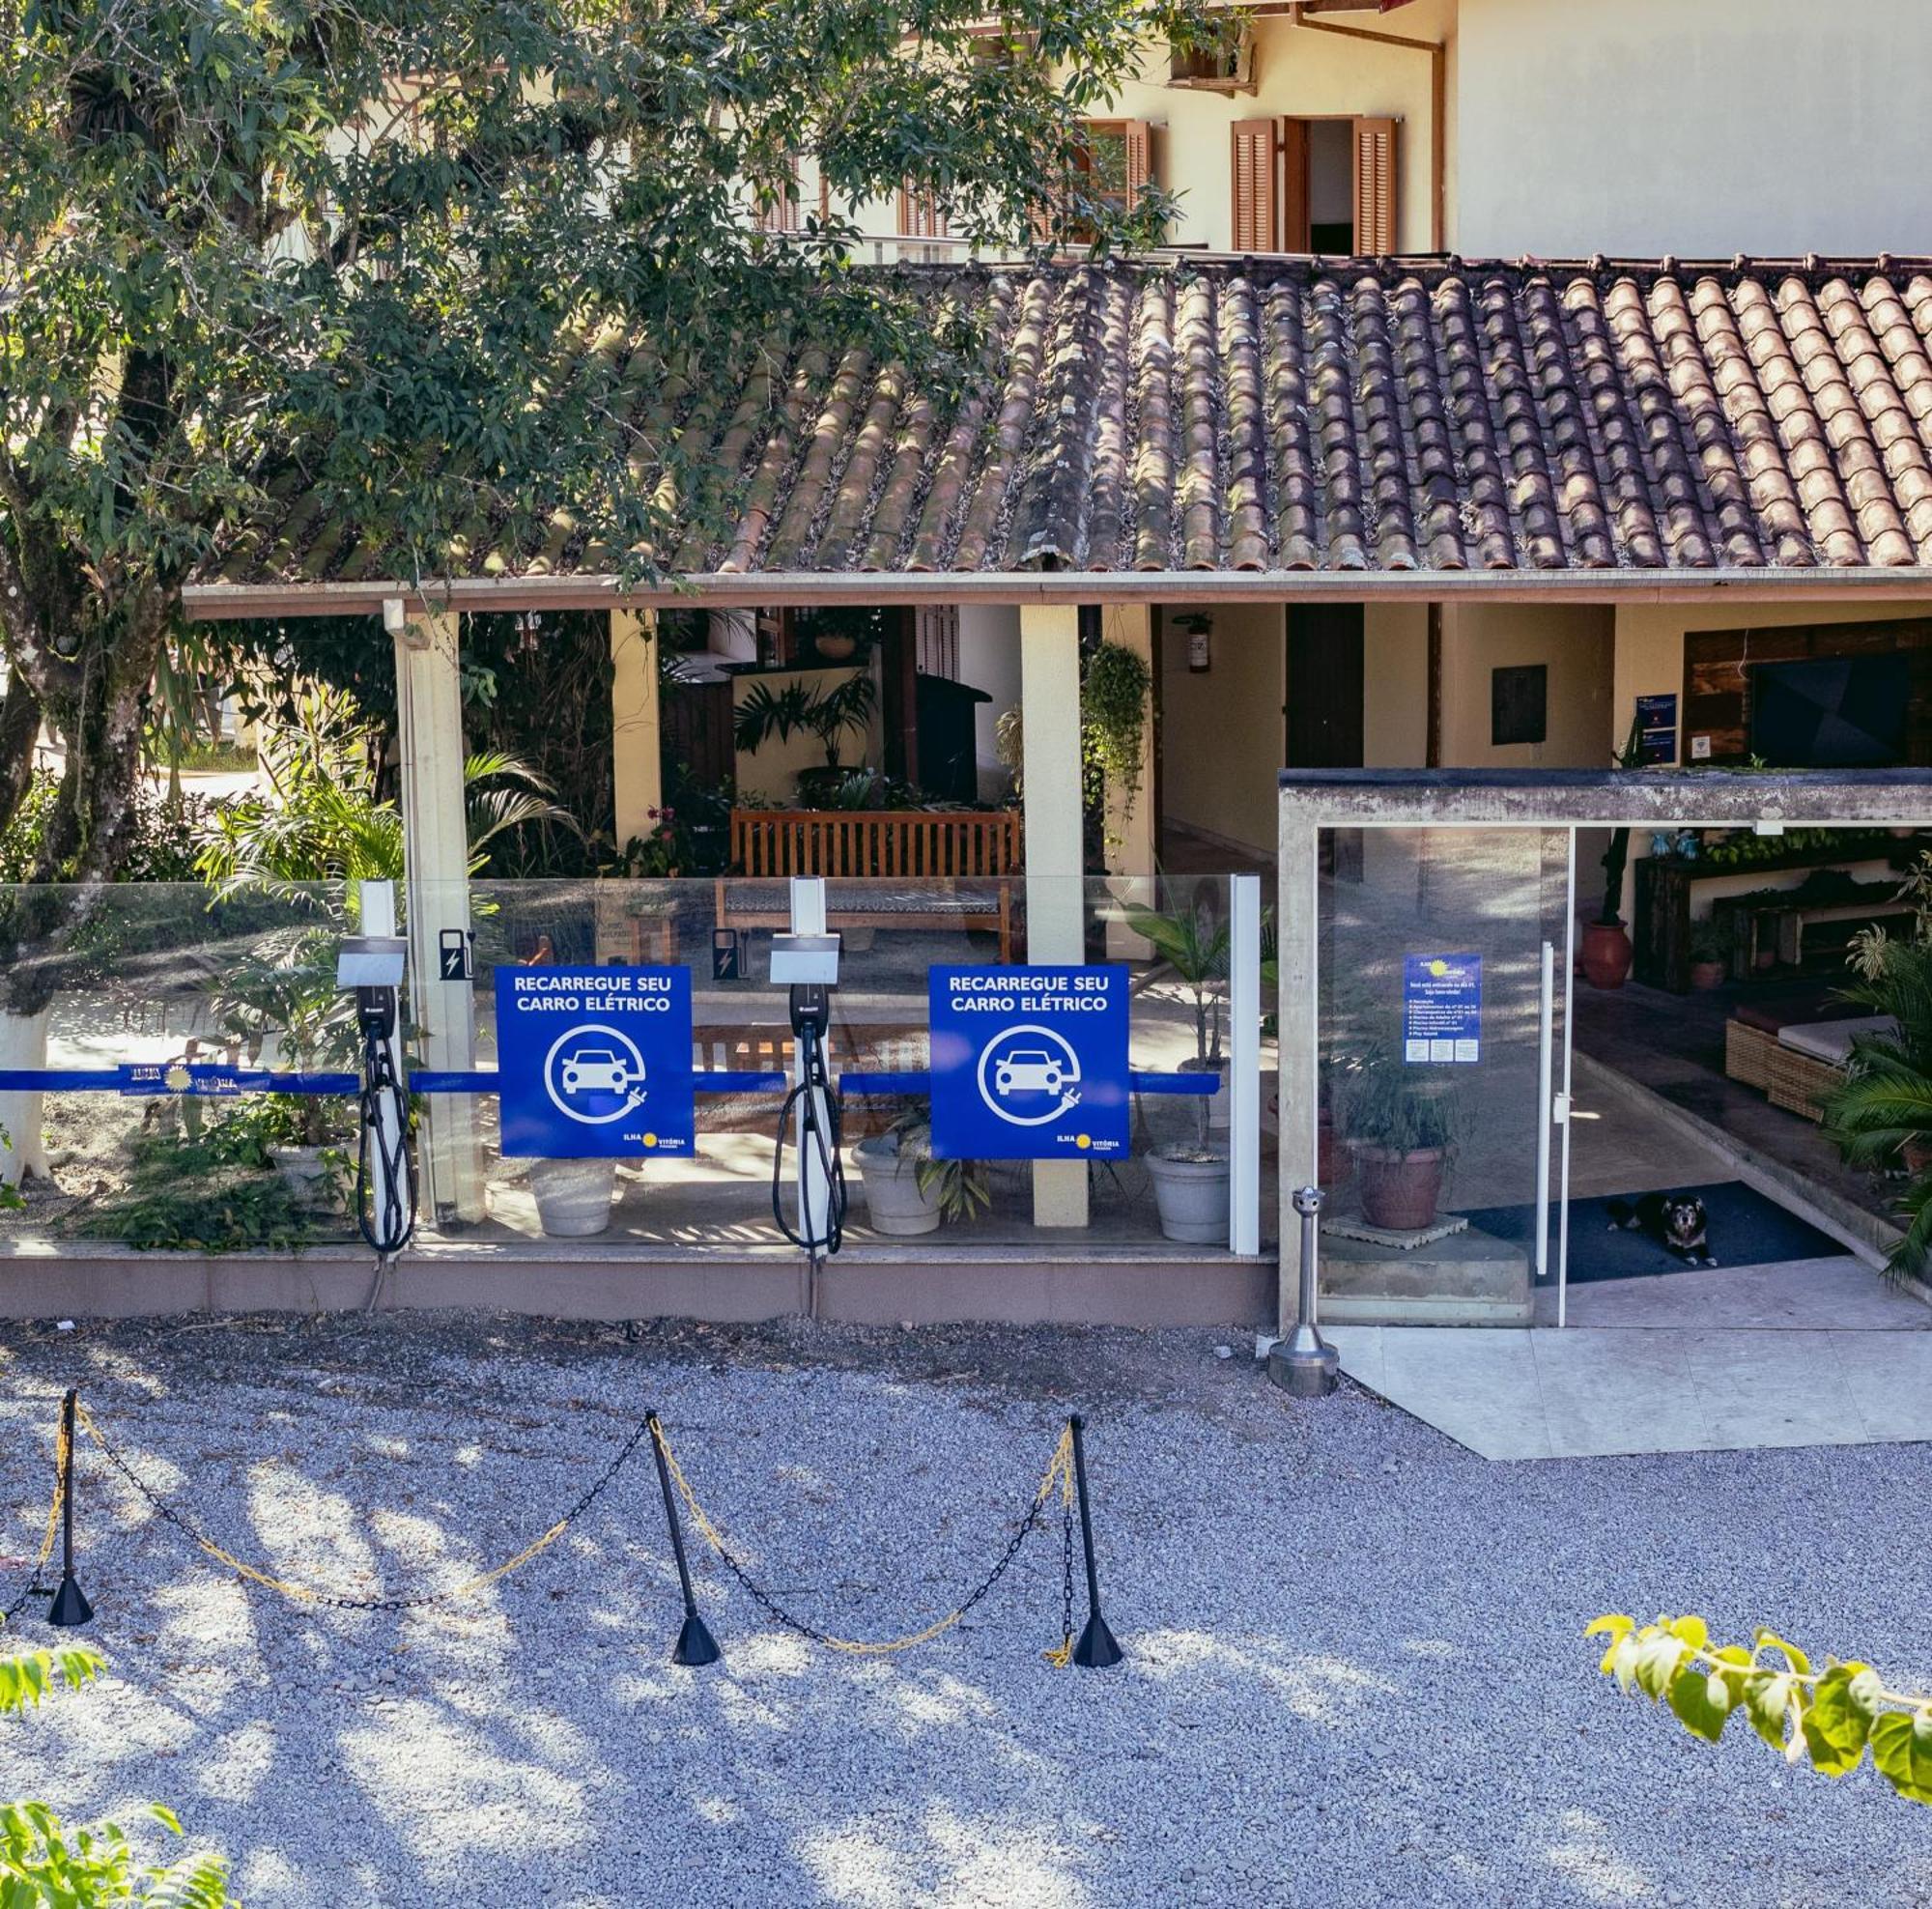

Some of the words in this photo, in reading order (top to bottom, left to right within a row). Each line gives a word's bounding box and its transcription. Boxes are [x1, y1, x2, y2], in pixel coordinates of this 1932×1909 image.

[514, 977, 632, 991] RECARREGUE
[637, 977, 672, 992] SEU
[950, 977, 1068, 991] RECARREGUE
[1073, 977, 1109, 991] SEU
[517, 996, 580, 1011] CARRO
[584, 992, 670, 1011] ELÉTRICO
[951, 996, 1015, 1011] CARRO
[1020, 992, 1108, 1011] ELÉTRICO
